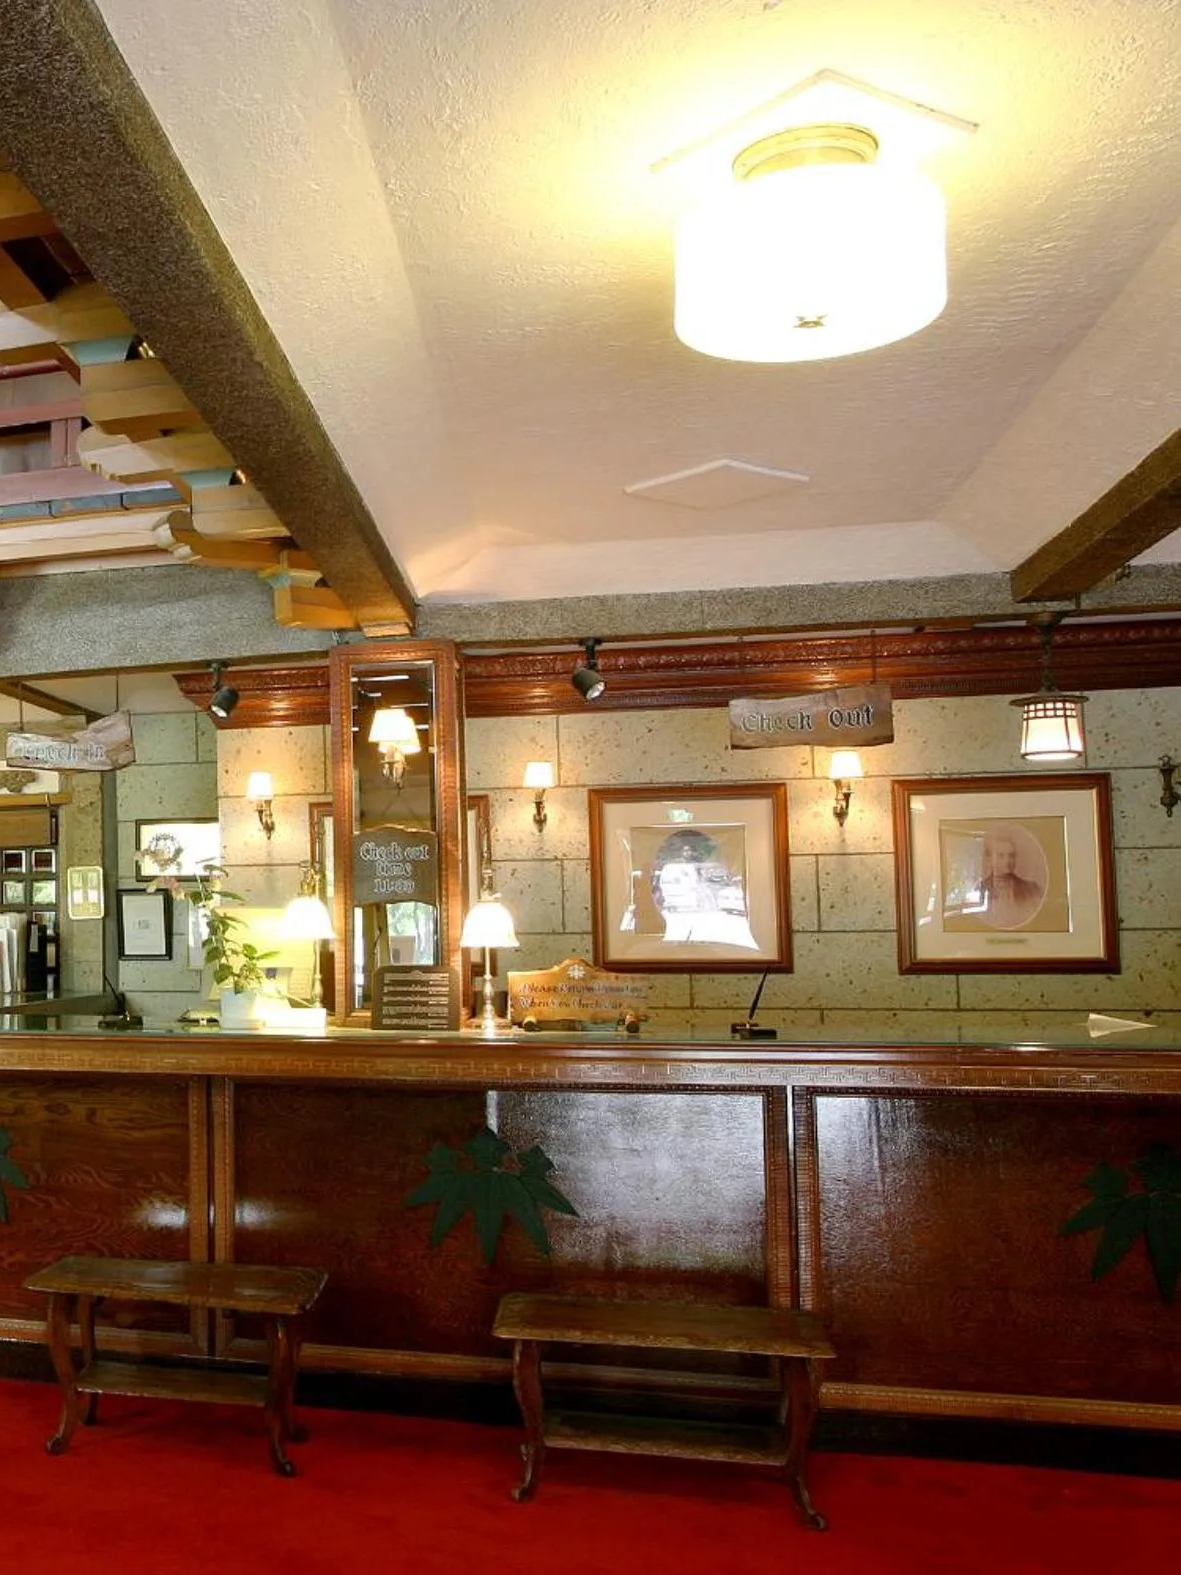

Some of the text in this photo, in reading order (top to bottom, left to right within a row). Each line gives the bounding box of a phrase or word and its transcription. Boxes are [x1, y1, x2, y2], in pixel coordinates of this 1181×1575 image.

[741, 704, 874, 733] Check Out
[360, 842, 402, 860] Check
